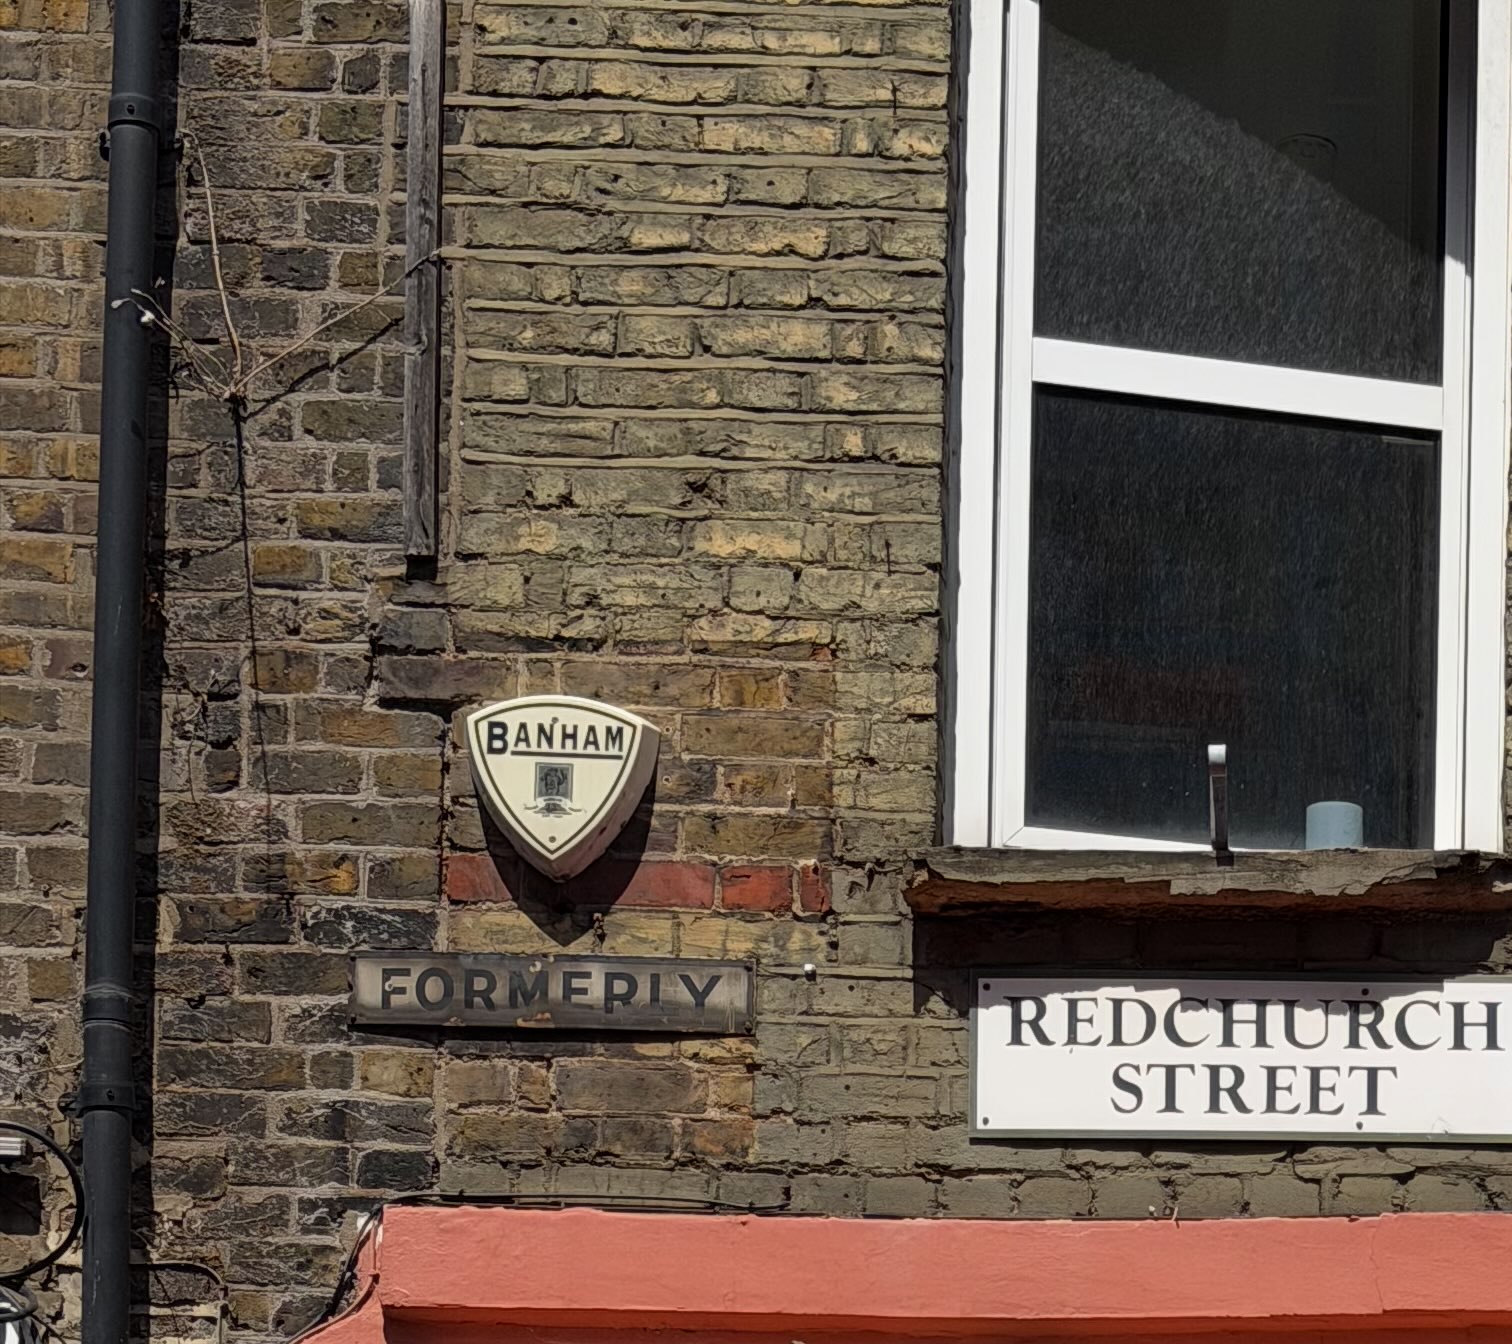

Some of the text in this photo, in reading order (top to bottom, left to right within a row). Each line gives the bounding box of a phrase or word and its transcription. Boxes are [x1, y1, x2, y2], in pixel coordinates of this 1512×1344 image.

[487, 720, 625, 756] BANHAM
[1004, 995, 1506, 1052] REDCHURCH
[1110, 1062, 1398, 1118] STREET
